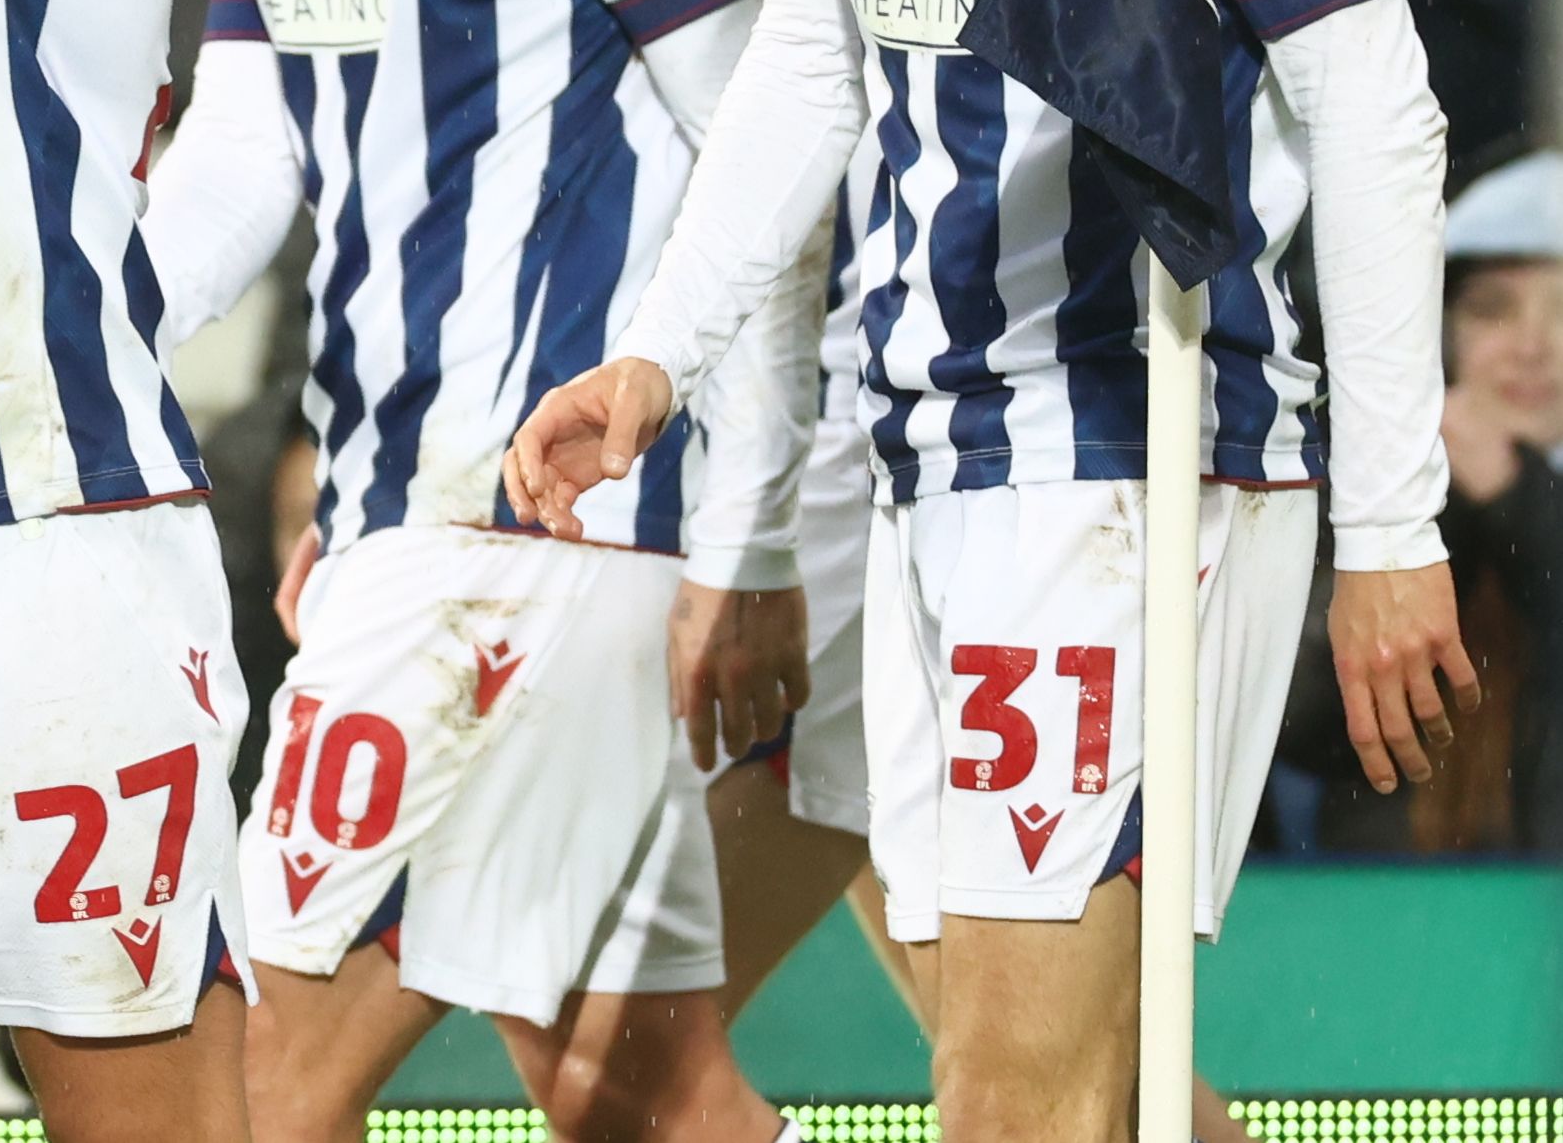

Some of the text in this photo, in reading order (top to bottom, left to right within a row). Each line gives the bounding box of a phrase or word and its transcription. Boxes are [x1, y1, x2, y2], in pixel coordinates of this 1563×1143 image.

[267, 693, 407, 851] 10
[950, 644, 1116, 795] 31
[14, 743, 199, 924] 27
